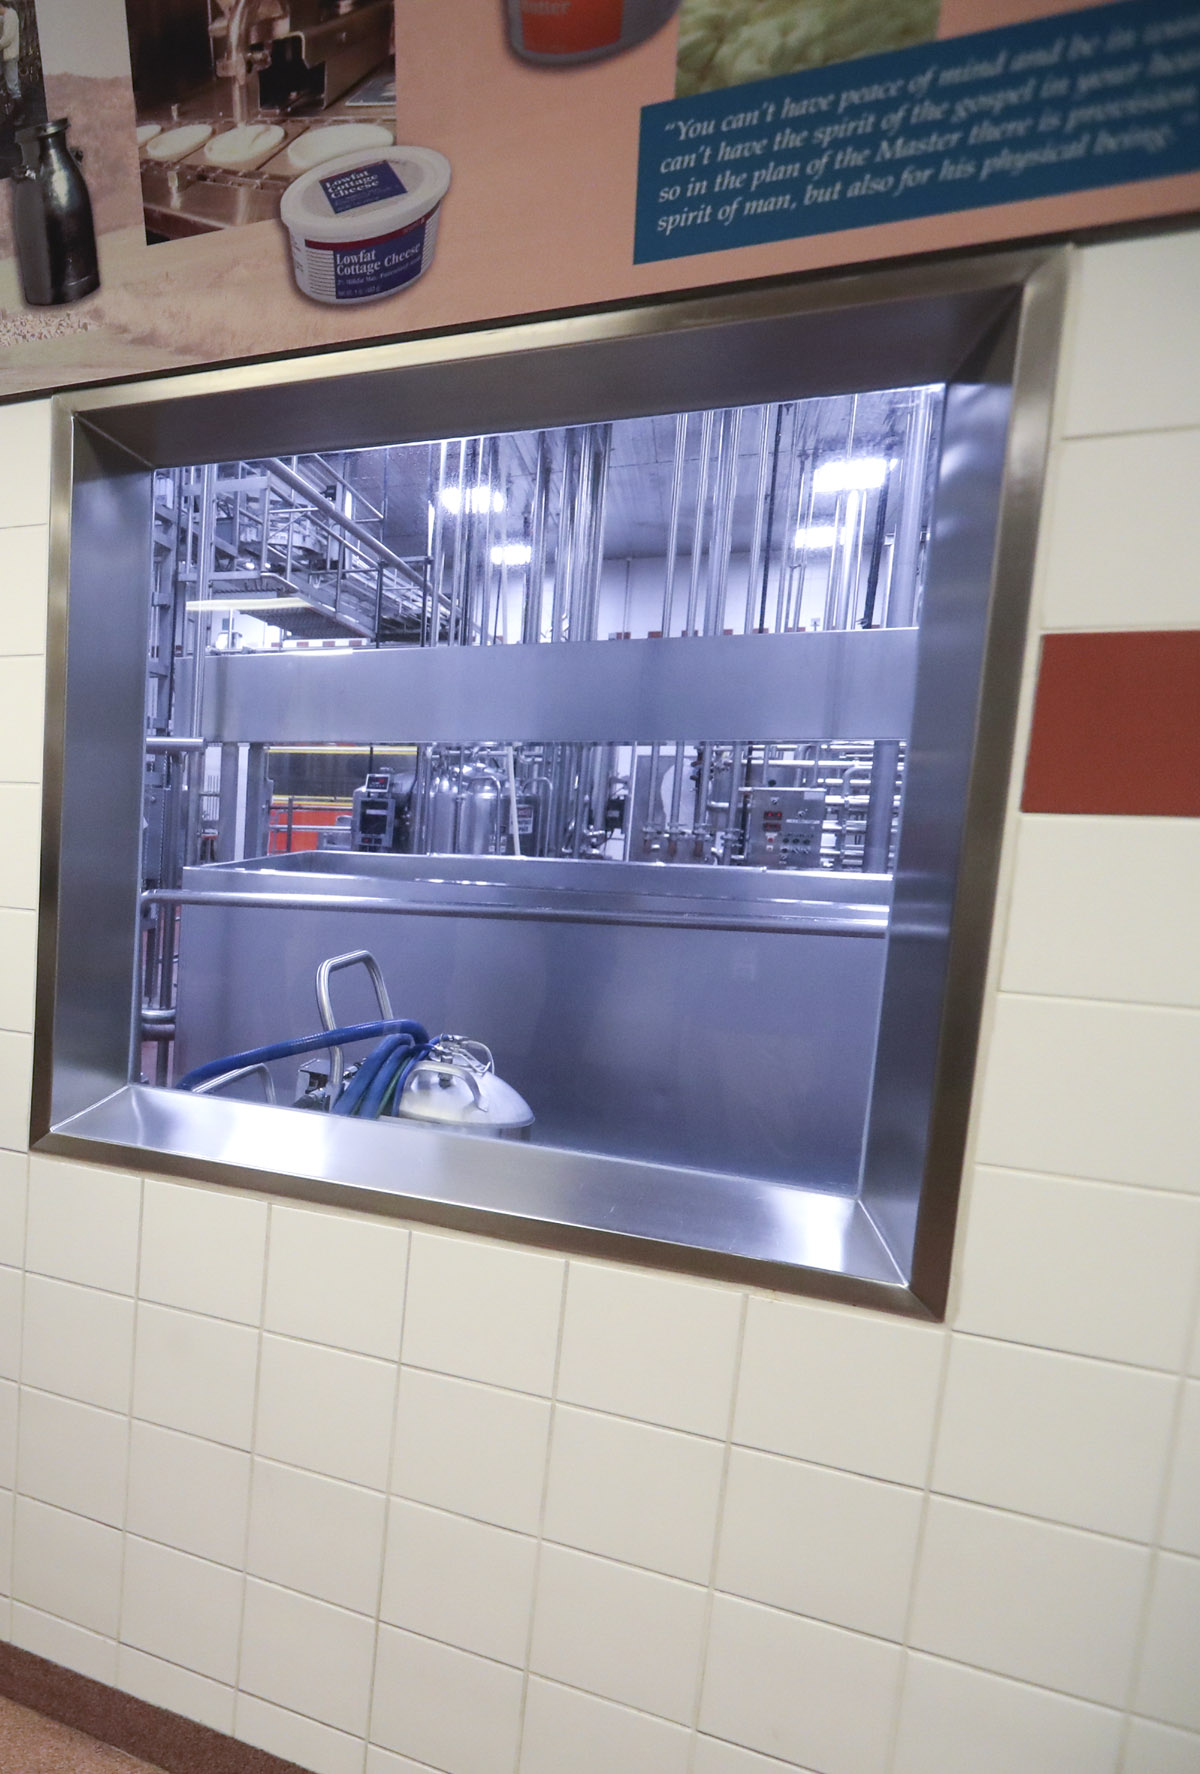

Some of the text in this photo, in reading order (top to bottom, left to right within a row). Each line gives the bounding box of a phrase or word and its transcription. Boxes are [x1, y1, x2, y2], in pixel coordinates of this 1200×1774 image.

[664, 118, 715, 141] "You
[721, 100, 777, 131] can't
[780, 96, 832, 120] have
[838, 78, 904, 114] peace
[907, 65, 938, 98] of
[938, 48, 1007, 87] mind
[1009, 36, 1065, 72] and
[660, 145, 712, 174] can't
[717, 138, 768, 163] have
[772, 127, 809, 151] the
[813, 112, 875, 147] spirit
[880, 103, 908, 137] of
[910, 98, 949, 125] the
[951, 77, 1036, 124] gospel
[1040, 74, 1071, 99] in
[1073, 62, 1142, 101] your
[658, 185, 681, 203] so
[686, 176, 708, 199] in
[713, 168, 748, 193] the
[751, 160, 801, 192] plan
[805, 148, 833, 182] of
[833, 145, 870, 171] the
[874, 130, 963, 163] Master
[967, 117, 1034, 146] there
[1037, 107, 1062, 132] is
[325, 170, 370, 188] Lowfat
[328, 174, 379, 194] Cottage
[330, 180, 379, 199] Cheese
[656, 204, 712, 236] spirit
[716, 195, 740, 226] of
[743, 190, 798, 218] man,
[803, 180, 842, 206] but
[846, 171, 895, 199] also
[893, 163, 935, 198] for
[937, 157, 977, 183] his
[978, 132, 1091, 182] physical
[336, 249, 376, 265] Lowfat
[336, 260, 381, 276] Cottage
[384, 243, 421, 267] Cheese
